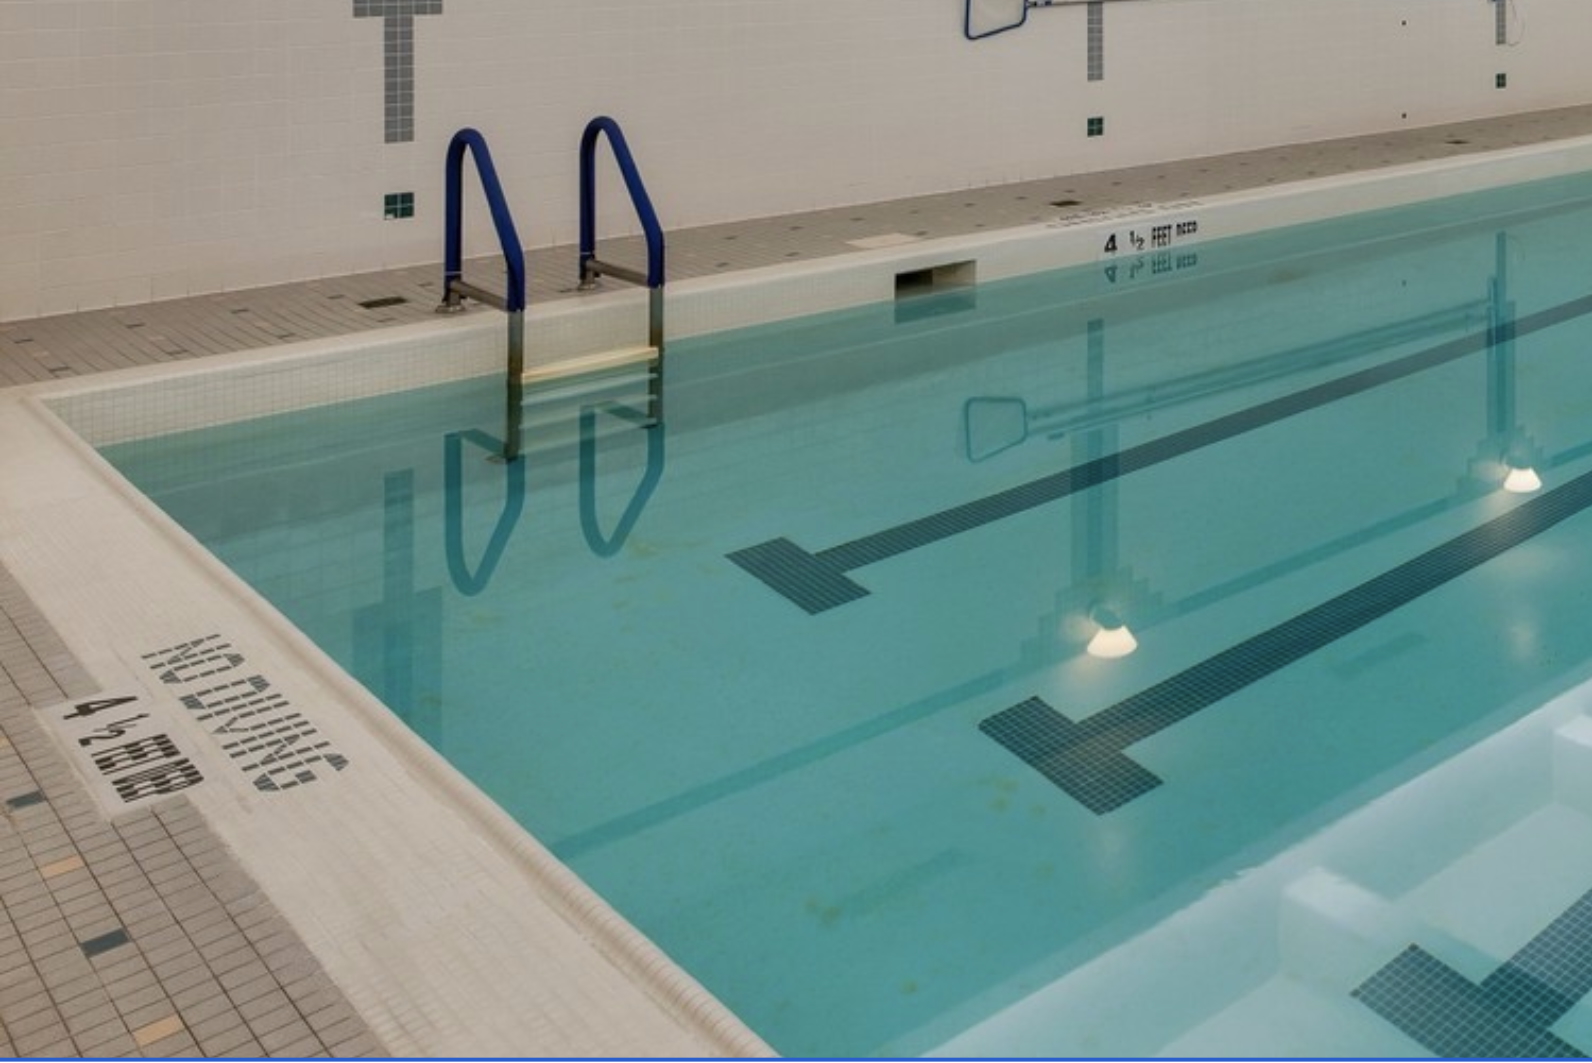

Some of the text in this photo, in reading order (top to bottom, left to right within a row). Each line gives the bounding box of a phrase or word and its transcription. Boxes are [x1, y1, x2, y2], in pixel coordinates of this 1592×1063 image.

[1104, 233, 1118, 254] 4
[1152, 224, 1172, 248] FEET
[63, 695, 138, 721] 4
[141, 634, 350, 792] NO DIVING
[91, 734, 181, 776] FEET
[112, 757, 205, 804] DEEP
